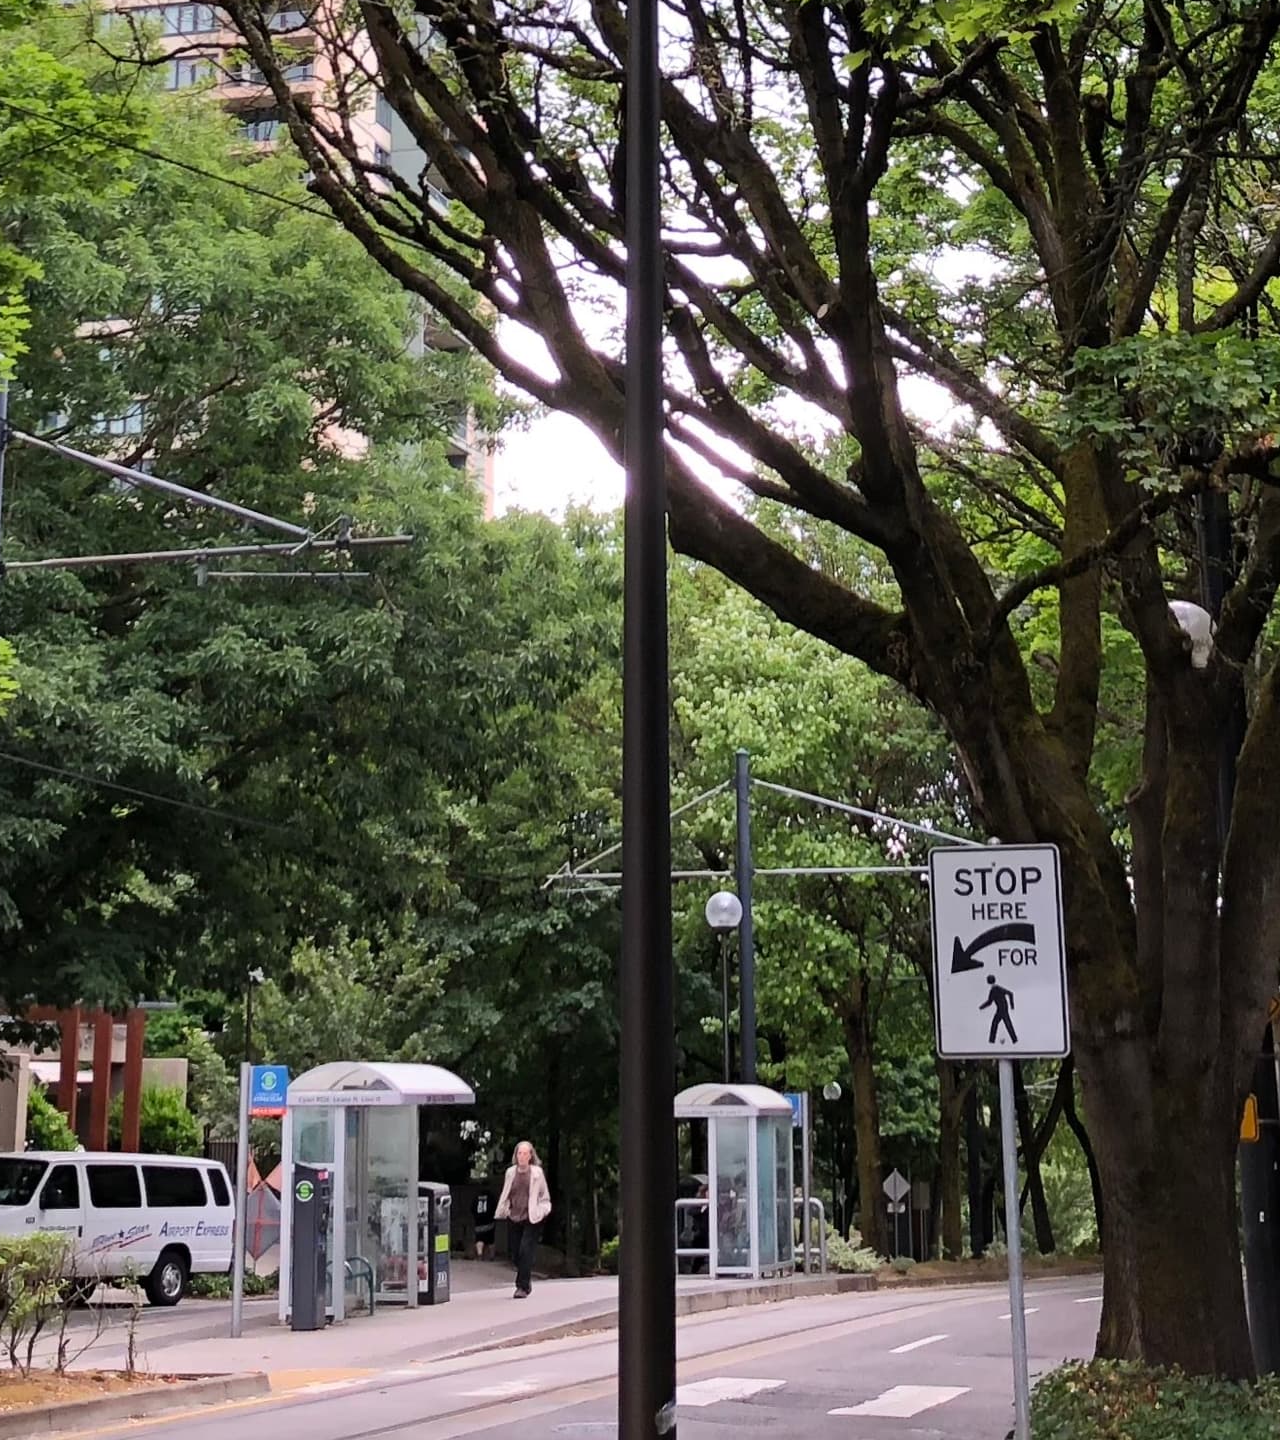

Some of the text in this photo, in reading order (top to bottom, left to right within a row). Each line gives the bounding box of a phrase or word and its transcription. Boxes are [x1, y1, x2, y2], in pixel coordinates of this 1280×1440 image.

[953, 866, 1042, 896] STOP
[972, 902, 1028, 920] HERE
[998, 948, 1038, 966] FOR
[159, 1221, 230, 1237] AIRPORT EXPRESS
